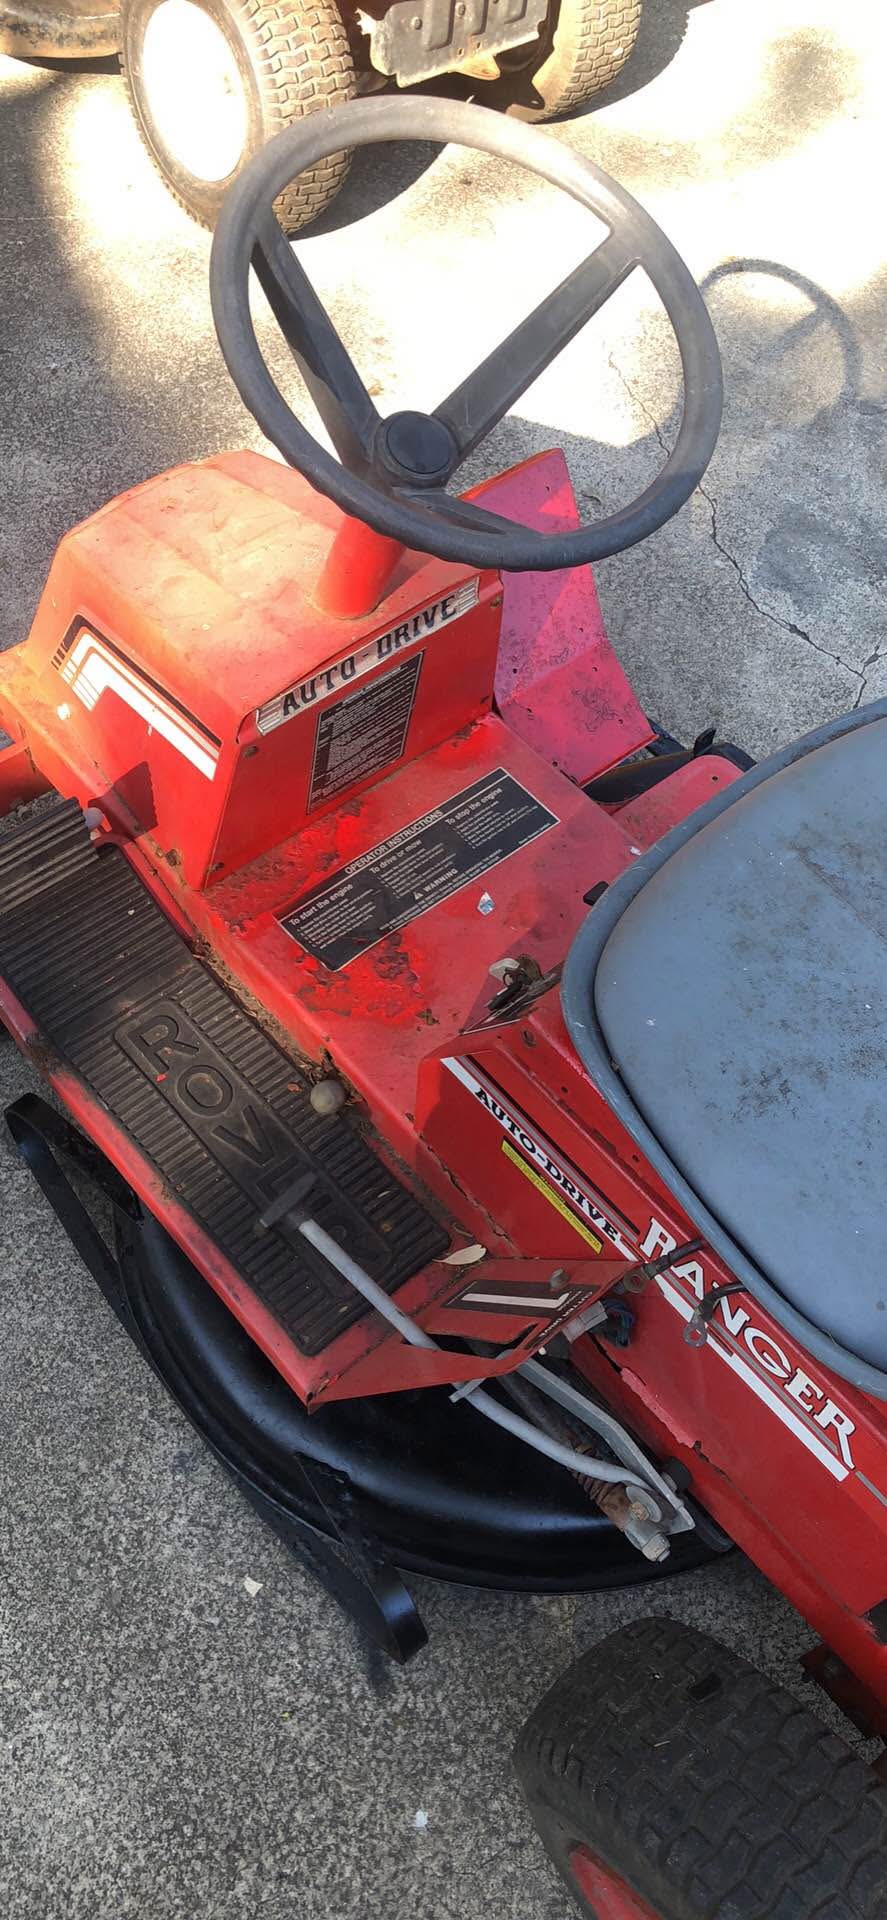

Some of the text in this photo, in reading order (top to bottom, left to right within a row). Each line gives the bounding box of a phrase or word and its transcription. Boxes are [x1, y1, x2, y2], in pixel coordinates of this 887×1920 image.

[444, 786, 503, 826] To stop the engine
[344, 844, 388, 875] OPERATOR
[386, 808, 444, 848] INSTRUCTIONS
[369, 838, 421, 875] To drive or mow
[422, 867, 459, 893] WARNING
[289, 882, 354, 927] To start the engine
[474, 1087, 618, 1242] AUTO-DRIVE
[639, 1216, 856, 1470] RANGER
